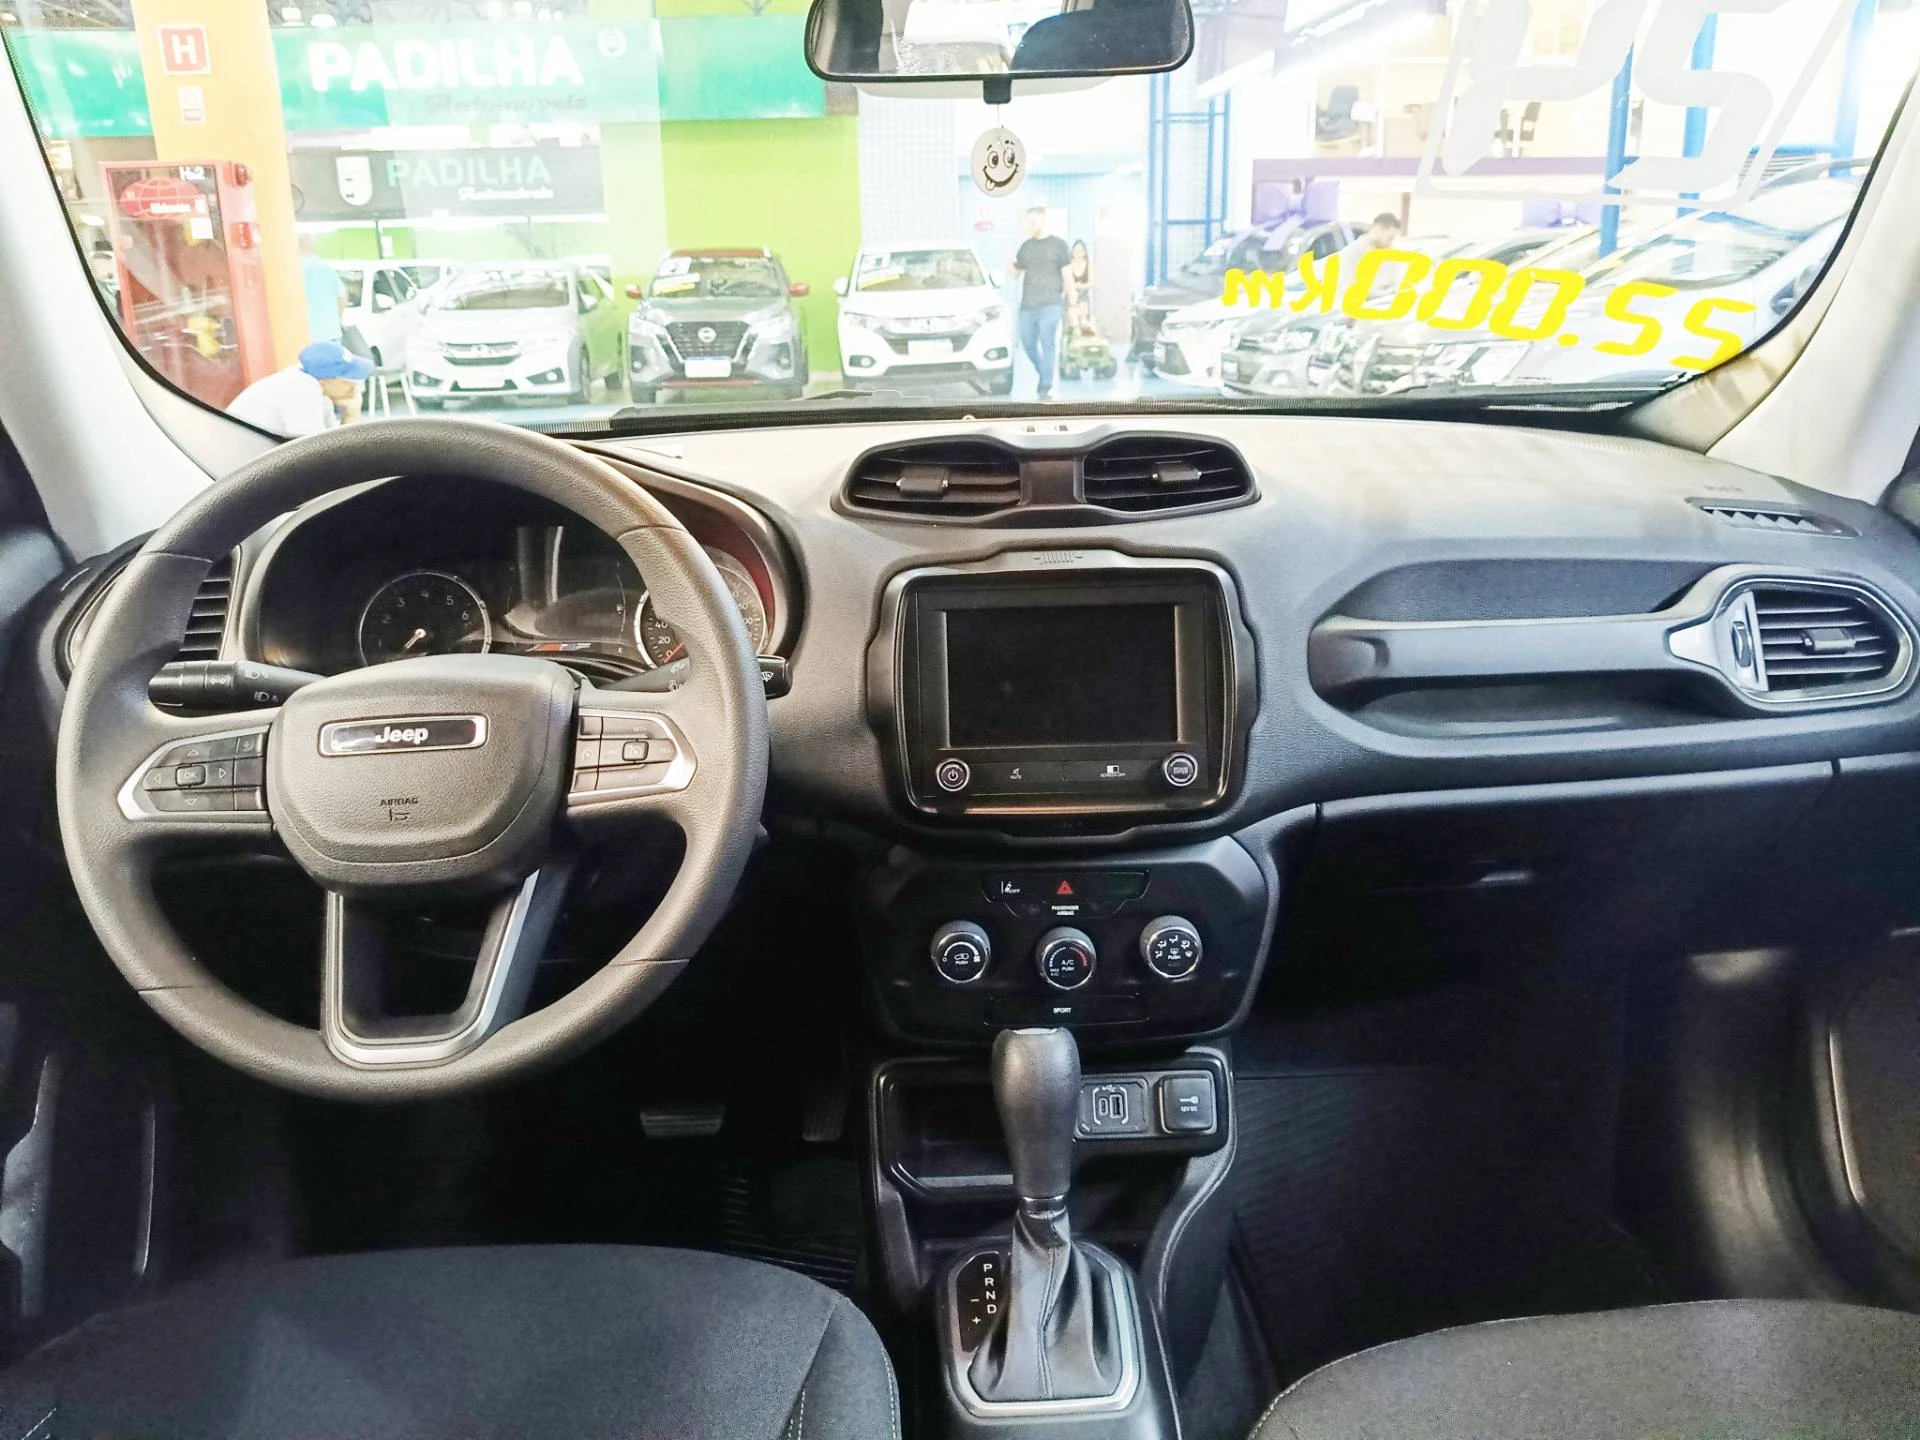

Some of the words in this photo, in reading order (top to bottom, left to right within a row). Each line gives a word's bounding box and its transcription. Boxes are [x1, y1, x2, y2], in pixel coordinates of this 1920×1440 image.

[171, 33, 199, 65] H
[306, 35, 586, 93] PADILHA
[386, 154, 554, 187] PADILHA
[397, 597, 406, 608] 3
[446, 595, 454, 606] 5
[381, 613, 391, 624] 2
[461, 611, 470, 621] 6
[655, 618, 669, 629] 40
[658, 636, 671, 644] 20
[375, 726, 429, 745] Jeep
[183, 769, 197, 780] OK
[379, 797, 419, 807] AIRBAG
[983, 1263, 993, 1273] P
[984, 1277, 995, 1287] R
[985, 1290, 997, 1300] N
[986, 1303, 998, 1314] D
